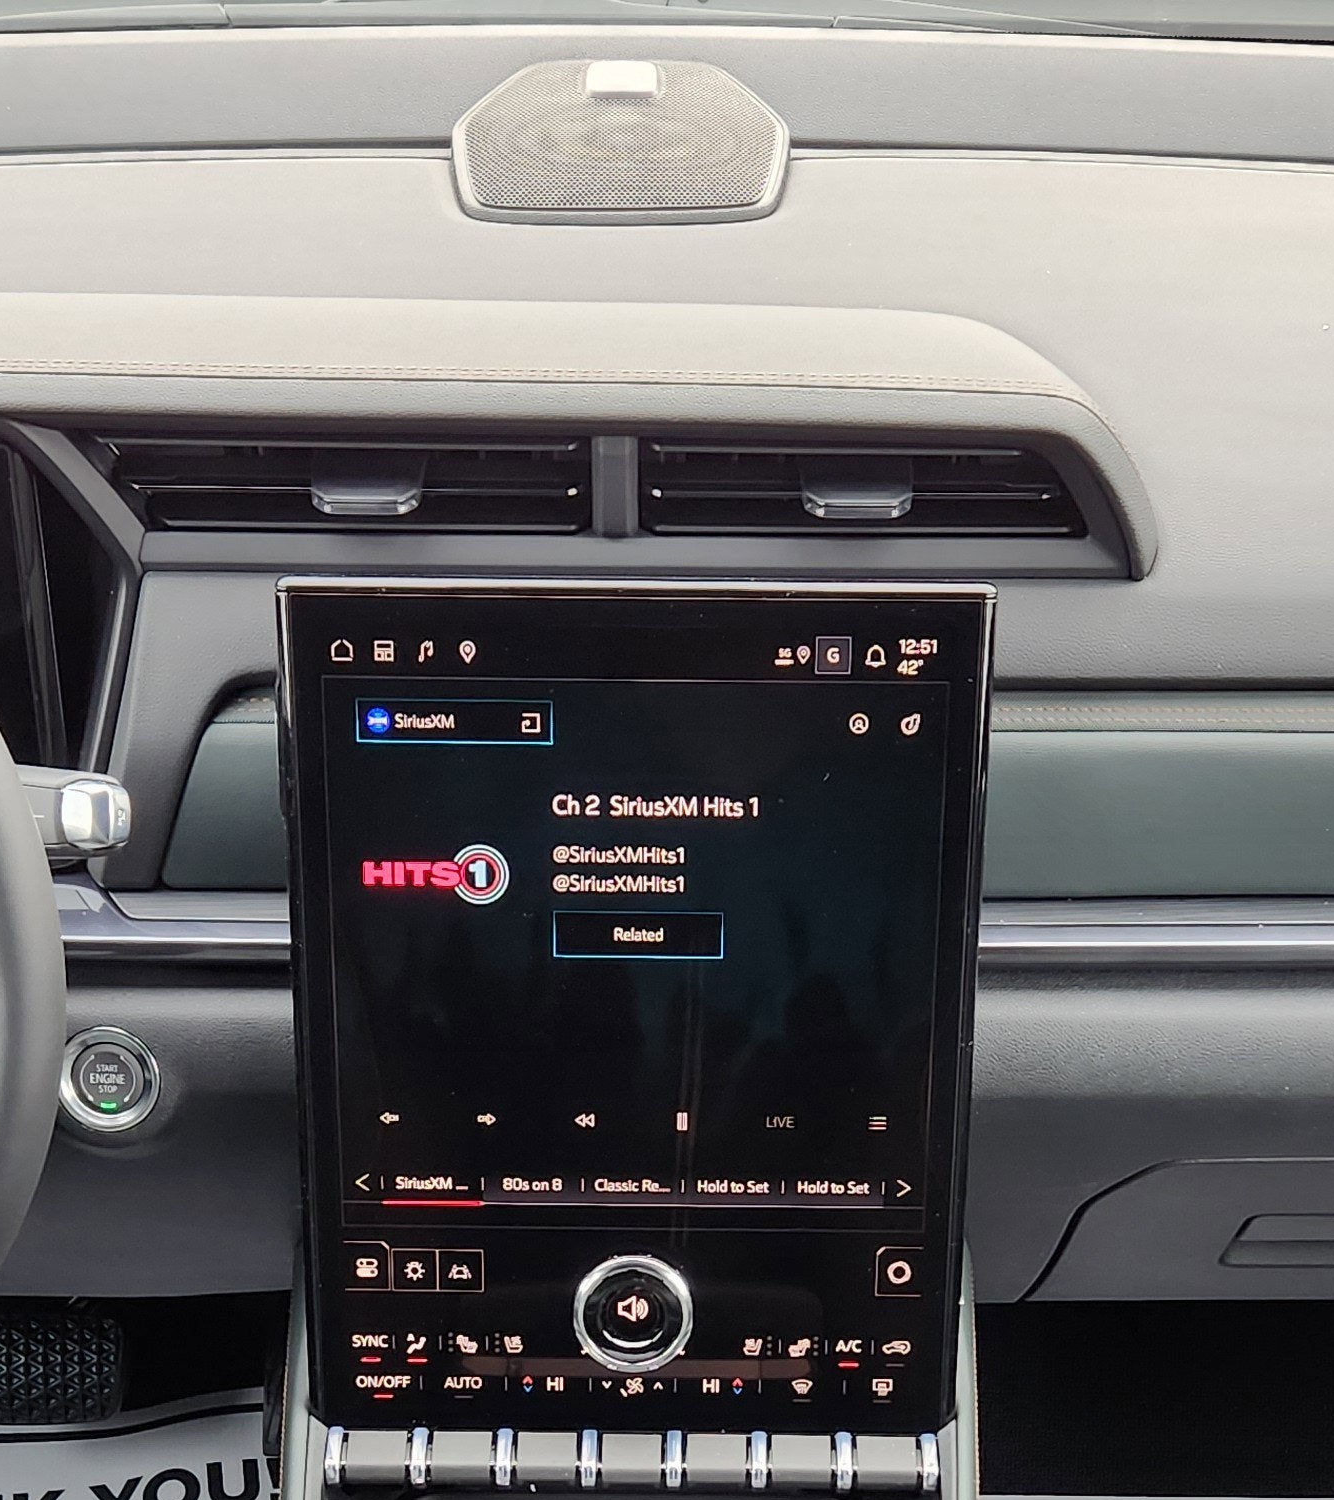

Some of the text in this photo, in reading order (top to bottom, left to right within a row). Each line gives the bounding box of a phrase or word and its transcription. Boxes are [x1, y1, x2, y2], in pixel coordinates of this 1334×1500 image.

[898, 638, 938, 655] 12:51
[826, 647, 840, 663] G
[896, 659, 924, 675] 42°
[394, 713, 455, 730] SiriusXM
[552, 795, 759, 818] Ch 2 SiriusXM Hits 1
[552, 847, 685, 866] @SiriusXMHits1
[552, 875, 685, 894] @SiriusXMHits1
[614, 928, 664, 943] Related
[96, 1064, 119, 1073] START
[89, 1073, 126, 1085] ENGINE
[98, 1085, 118, 1094] STOP
[766, 1116, 795, 1128] LIVE
[395, 1176, 453, 1190] SiriusXM
[502, 1178, 529, 1191] 80s
[532, 1180, 548, 1192] on
[594, 1178, 640, 1192] Classic
[697, 1180, 770, 1194] Hold to Set
[797, 1181, 870, 1195] Hold to Set
[351, 1334, 389, 1348] SYNC
[835, 1339, 862, 1353] A/C
[355, 1375, 412, 1389] ON/OFF
[443, 1376, 483, 1389] AUTO
[546, 1376, 564, 1391] HI
[702, 1378, 720, 1393] HI
